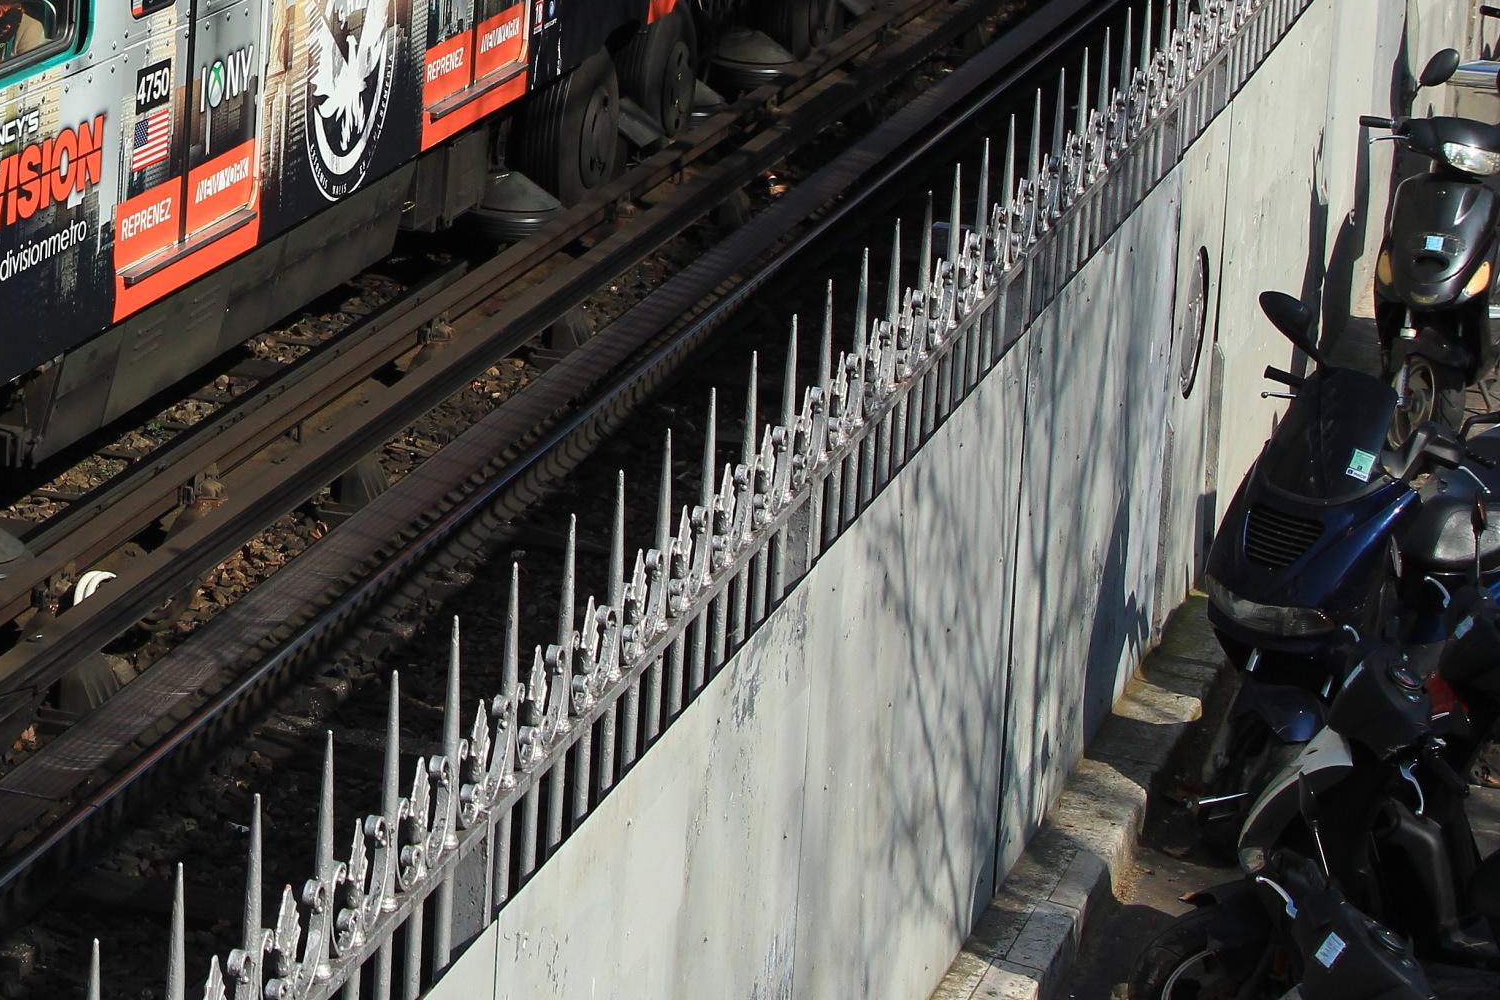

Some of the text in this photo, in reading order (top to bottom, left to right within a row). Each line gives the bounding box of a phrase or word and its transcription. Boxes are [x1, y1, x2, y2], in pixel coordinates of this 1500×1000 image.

[226, 44, 254, 101] NY
[427, 47, 464, 83] REPRENEZ
[137, 67, 170, 106] 4750
[121, 197, 172, 241] REPRENEZ
